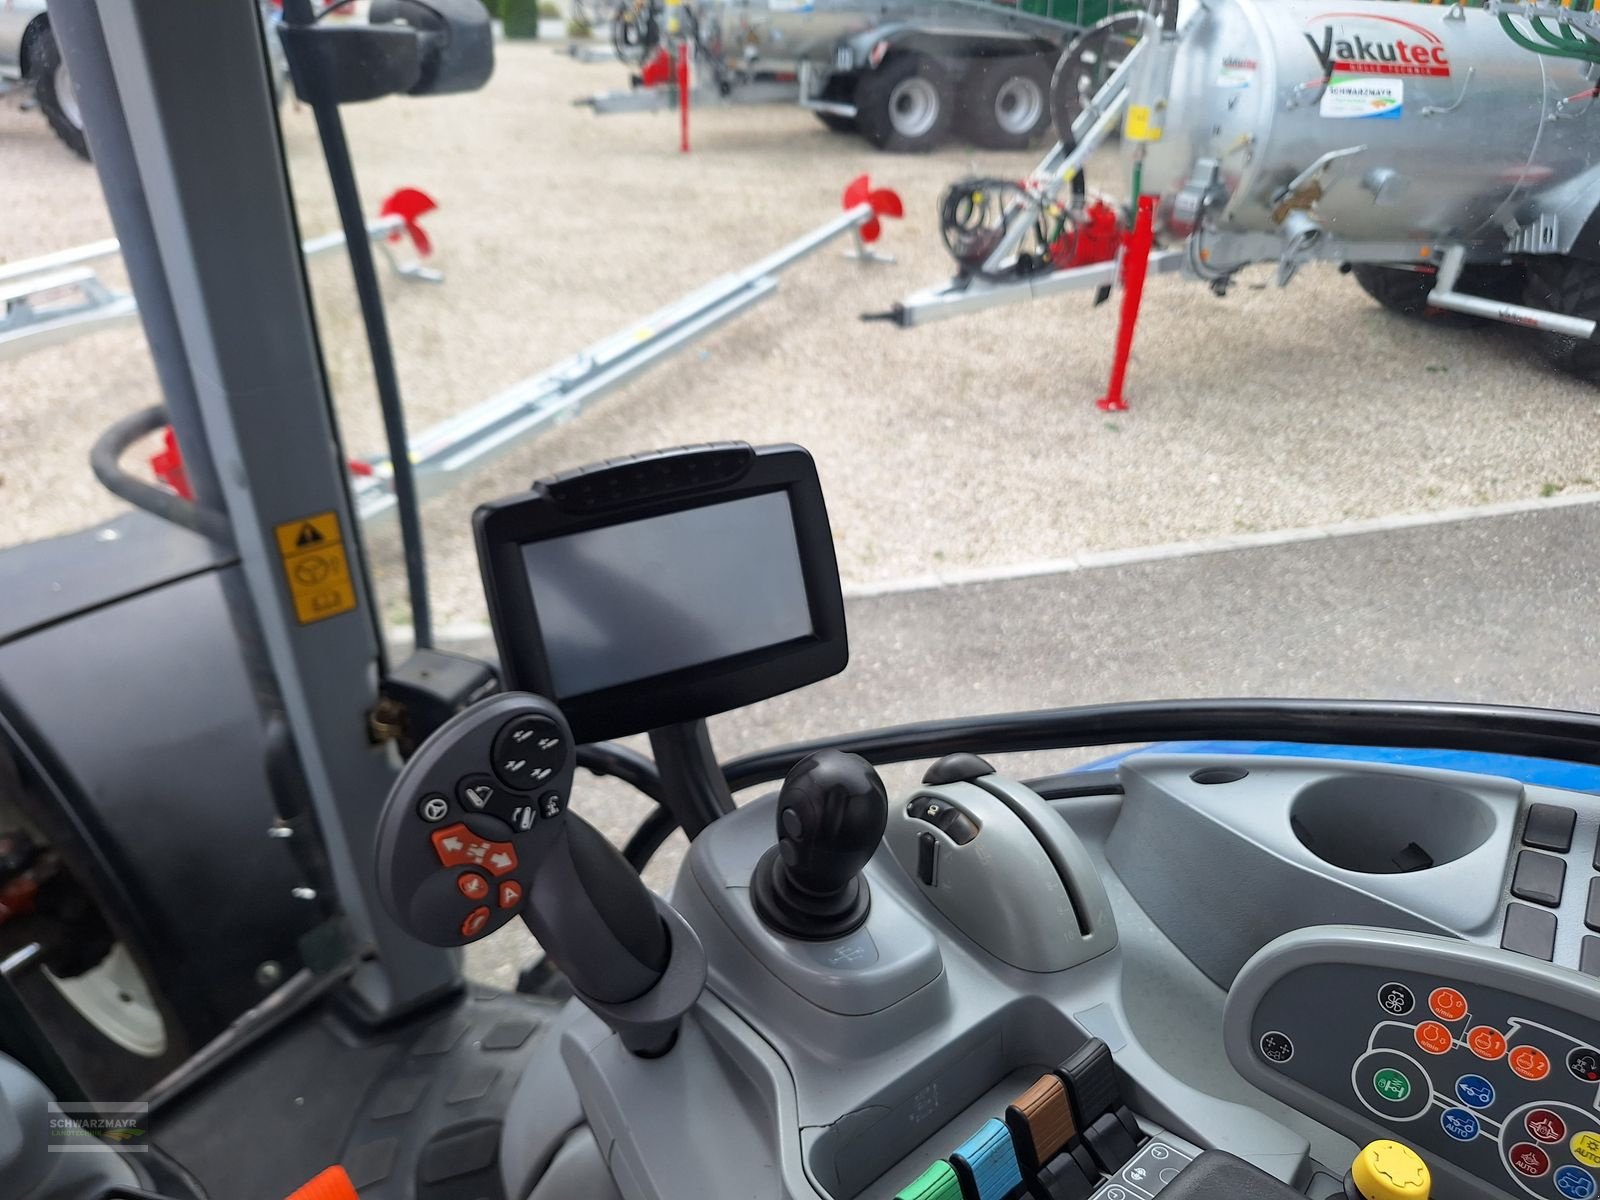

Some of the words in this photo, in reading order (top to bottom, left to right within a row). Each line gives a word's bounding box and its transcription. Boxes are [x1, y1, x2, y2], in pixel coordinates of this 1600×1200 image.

[1536, 1061, 1545, 1071] 2
[1445, 1123, 1468, 1138] AUTO
[1573, 1147, 1600, 1164] AUTO
[1515, 1160, 1537, 1175] AUTO
